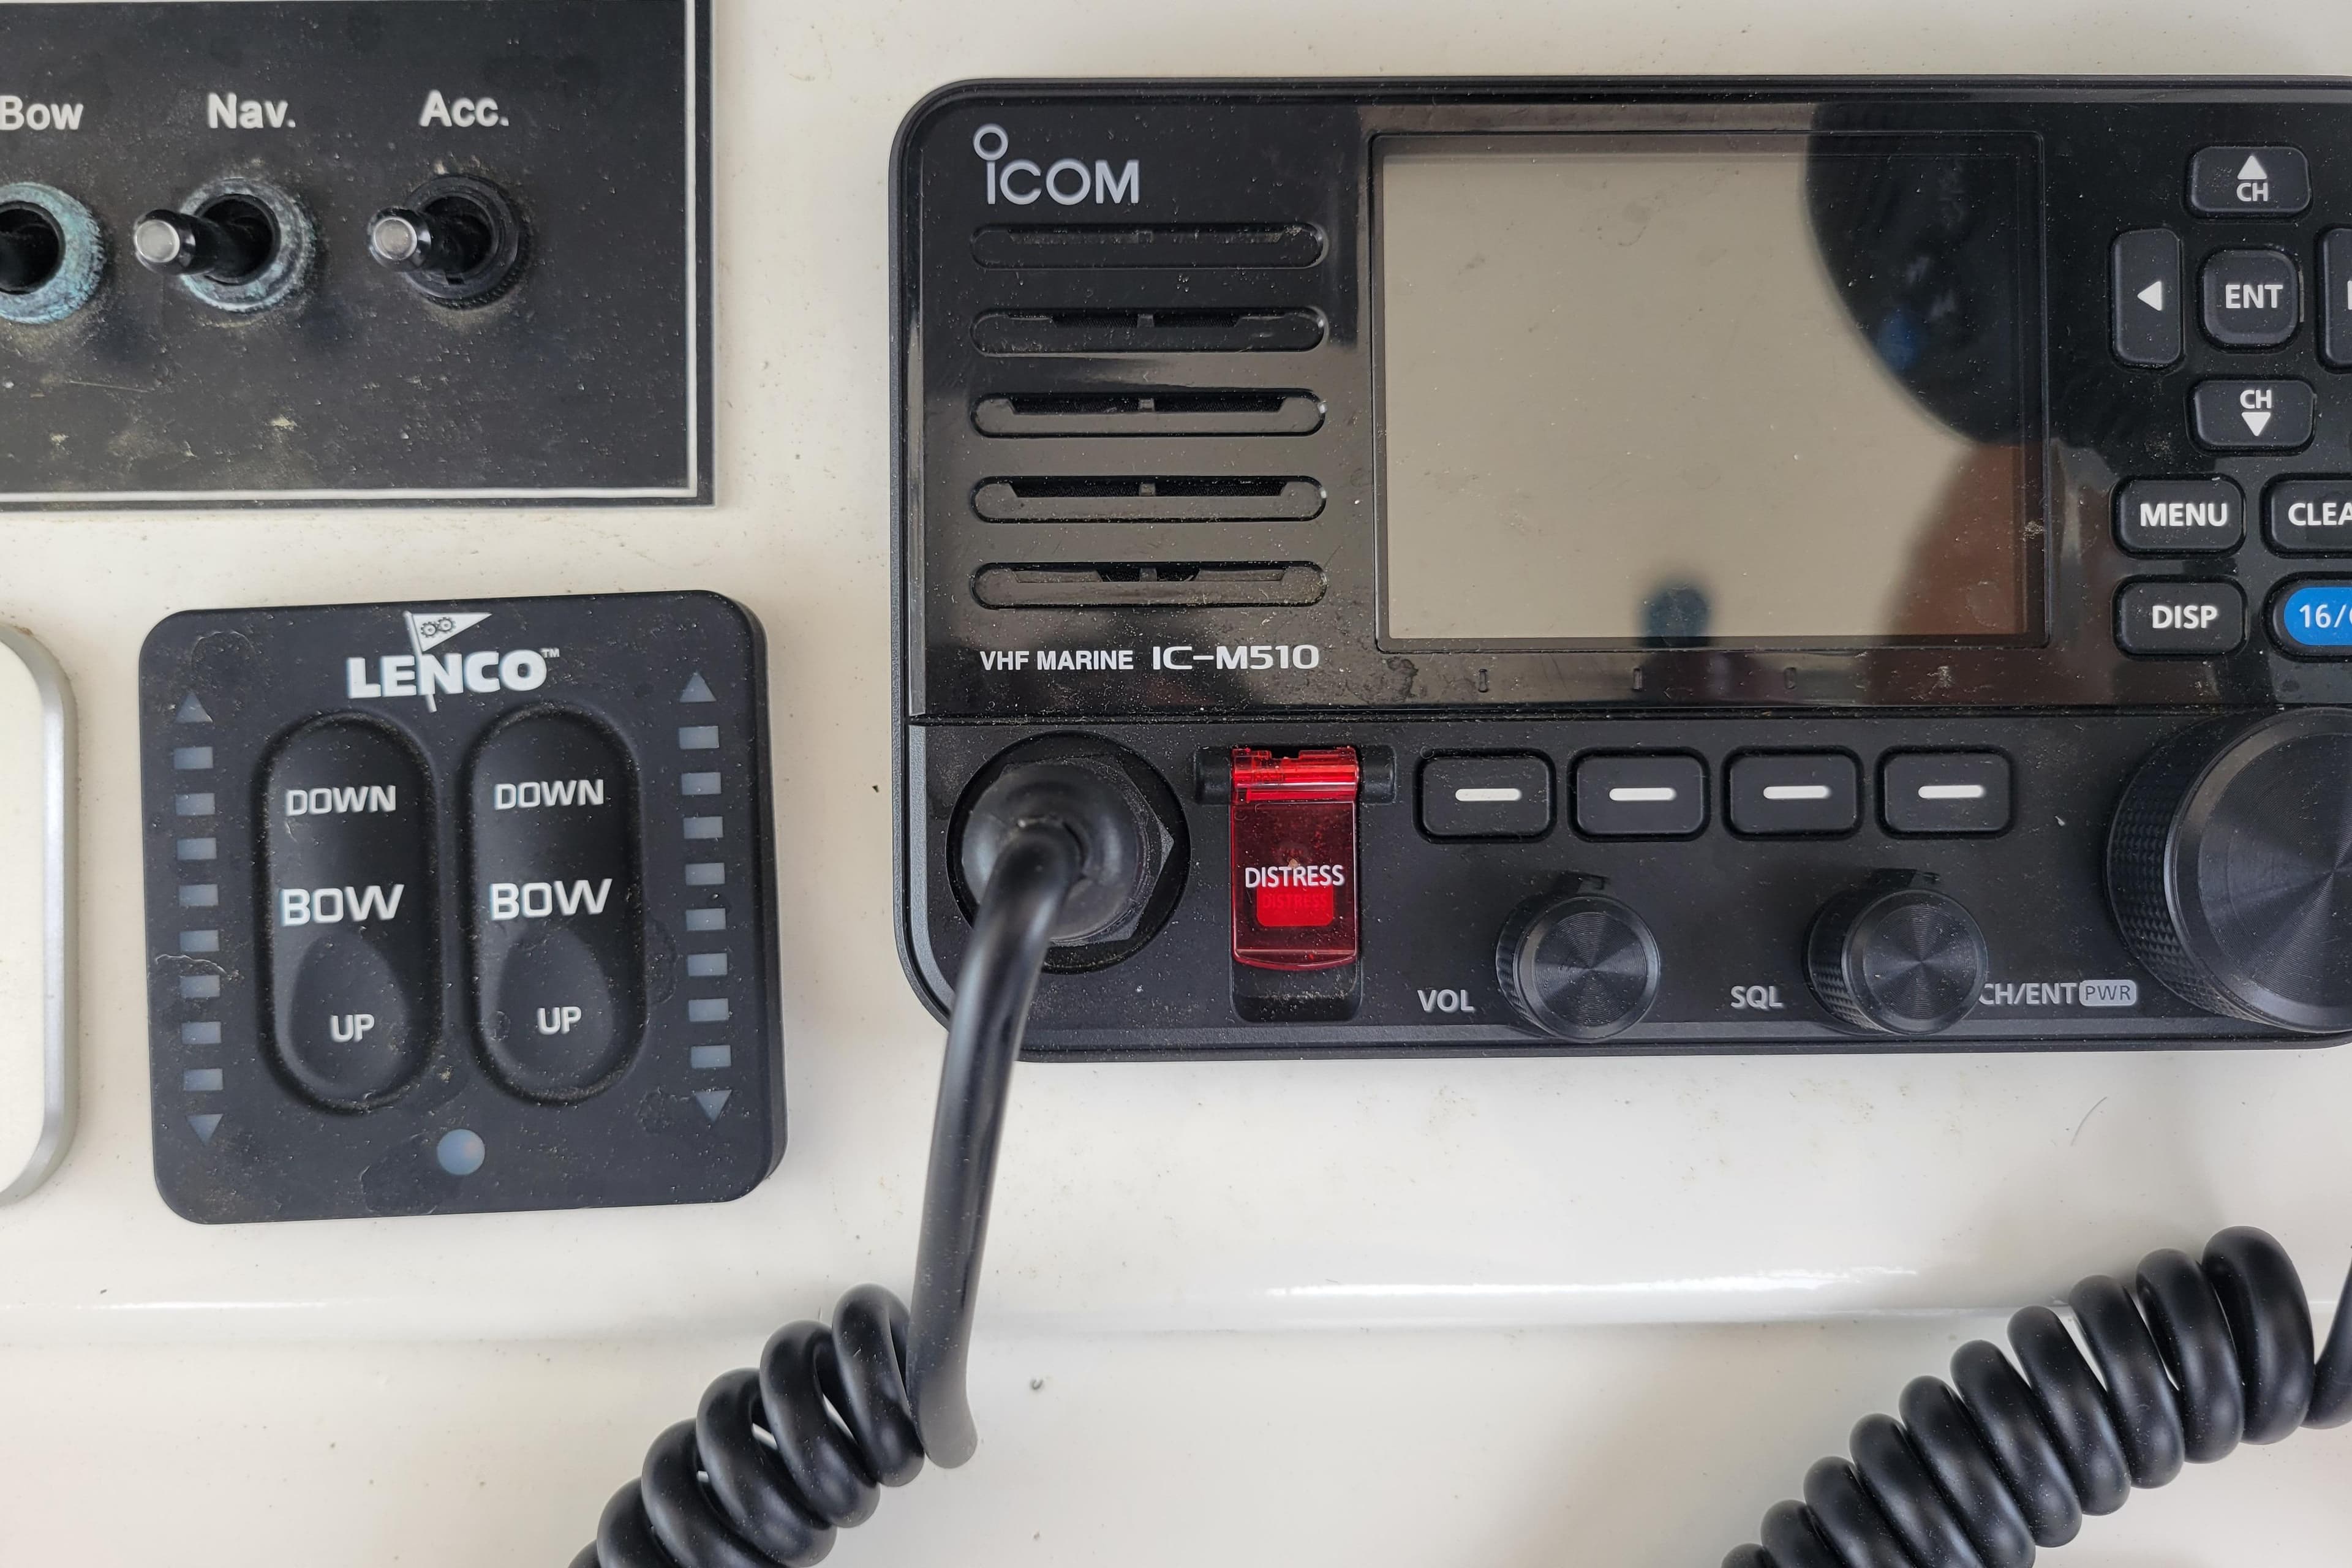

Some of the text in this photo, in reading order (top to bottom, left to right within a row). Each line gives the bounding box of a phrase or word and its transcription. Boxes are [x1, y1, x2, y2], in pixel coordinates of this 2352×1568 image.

[0, 95, 84, 130] Bow
[207, 92, 296, 129] Nav.
[419, 89, 510, 127] Acc.
[2236, 182, 2269, 202] CH
[2225, 284, 2283, 309] ENT
[2240, 389, 2272, 409] CH
[2139, 503, 2228, 527] MENU
[2152, 605, 2218, 629] DISP
[2299, 604, 2352, 628] 16/
[979, 644, 1320, 671] VHF MARINE IC-M510
[285, 785, 396, 817] DOWN
[494, 778, 605, 810] DOWN
[1245, 864, 1346, 888] DISTRESS
[279, 883, 404, 927] BOW
[489, 878, 612, 921] BOW
[1262, 892, 1328, 909] DISTRESS
[1417, 989, 1476, 1012] VOL
[1730, 985, 1784, 1011] SQL
[2084, 985, 2132, 1001] PWR
[331, 1014, 375, 1042] UP
[537, 1006, 582, 1035] UP
